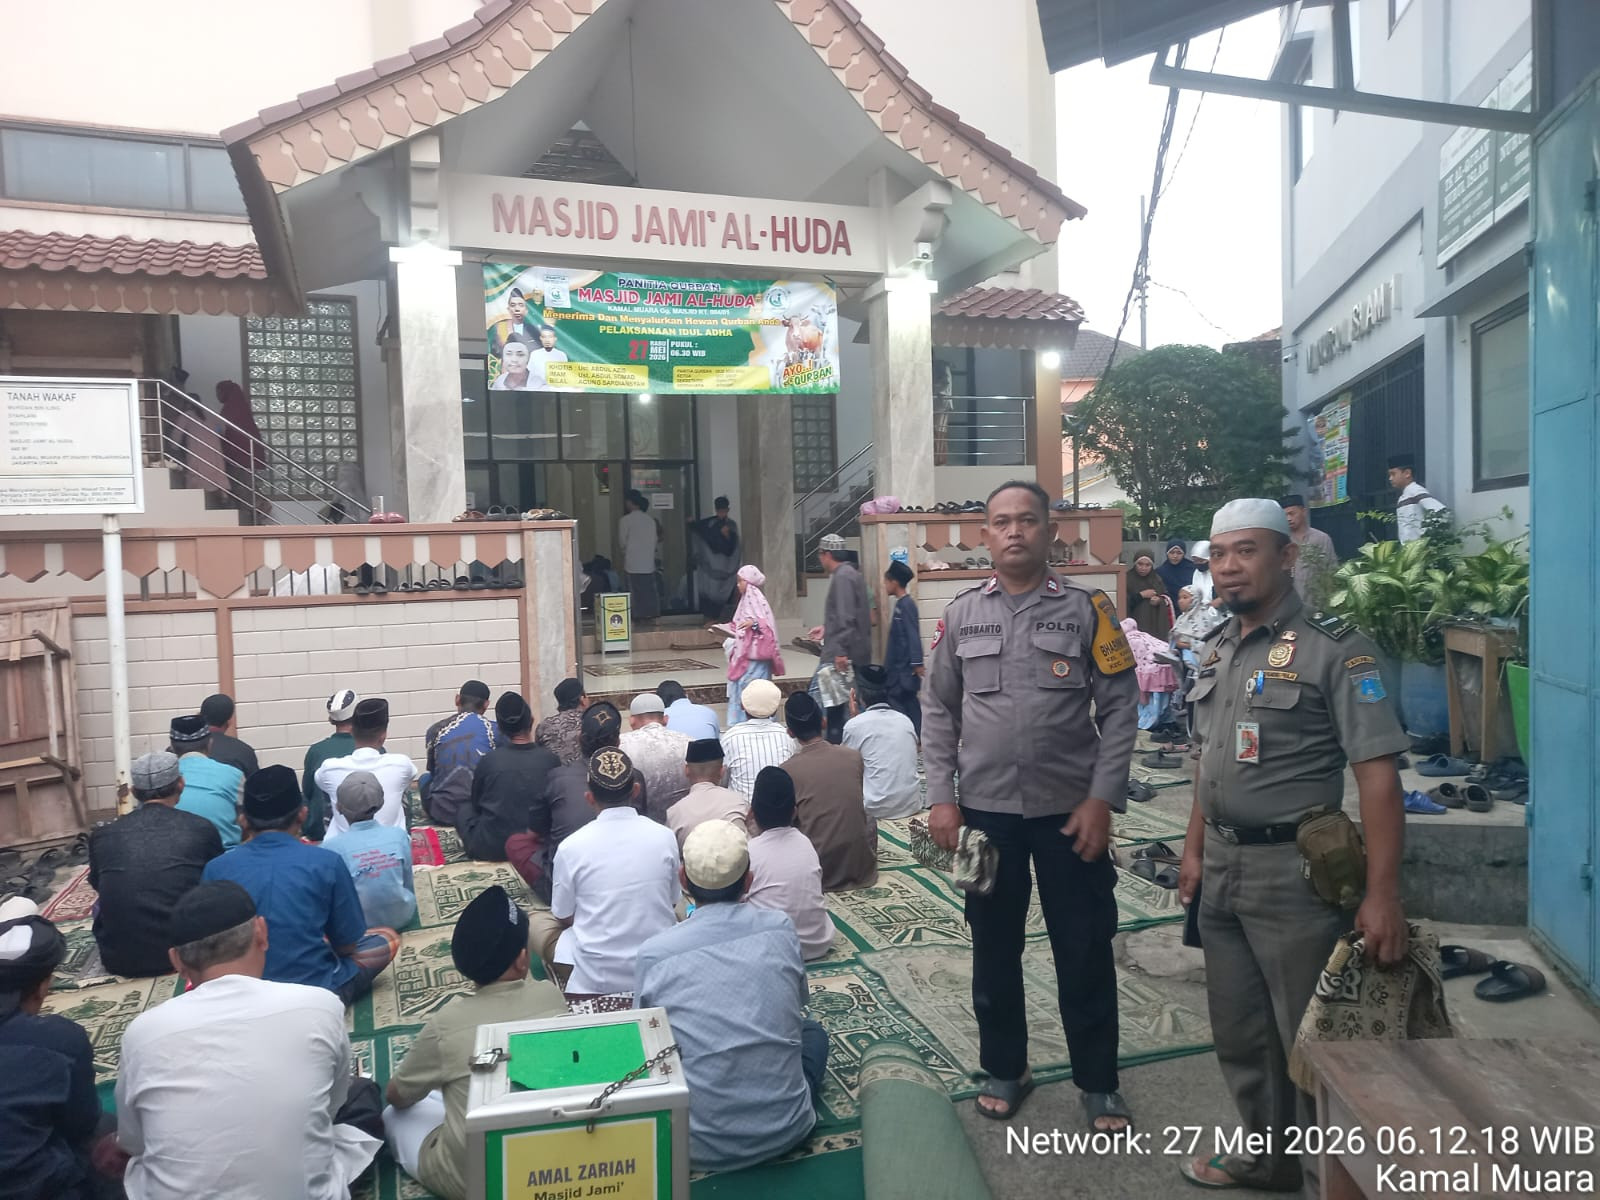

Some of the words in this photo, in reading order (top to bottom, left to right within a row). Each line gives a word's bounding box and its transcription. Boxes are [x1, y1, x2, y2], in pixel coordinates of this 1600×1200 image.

[491, 192, 619, 241] MASJID
[721, 212, 852, 256] AL-HUDA
[618, 278, 667, 291] PANITIA
[669, 280, 721, 292] QURBAN
[577, 287, 640, 304] MASJID
[644, 290, 684, 307] JAMI
[686, 292, 756, 308] AL-HUDA
[634, 306, 659, 314] MUARA
[543, 309, 595, 321] Menerima
[598, 313, 617, 322] Dan
[619, 314, 683, 326] Menyalurkan
[684, 317, 719, 325] Hewan
[720, 317, 755, 326] Qurban
[599, 325, 677, 336] PELAKSANAAN
[679, 327, 703, 337] IDUL
[705, 328, 733, 337] ADHA
[628, 339, 649, 360] 27
[650, 346, 666, 354] MEI
[670, 340, 694, 348] PUKUL
[670, 349, 691, 357] 06.30
[692, 349, 707, 357] WIB
[7, 392, 40, 401] TANAH
[42, 393, 77, 402] WAKAF
[1036, 622, 1080, 634] POLRI
[527, 1166, 573, 1188] AMAL
[578, 1158, 637, 1182] ZARIAH
[533, 1186, 582, 1200] Masjid
[586, 1181, 625, 1197] Jami'
